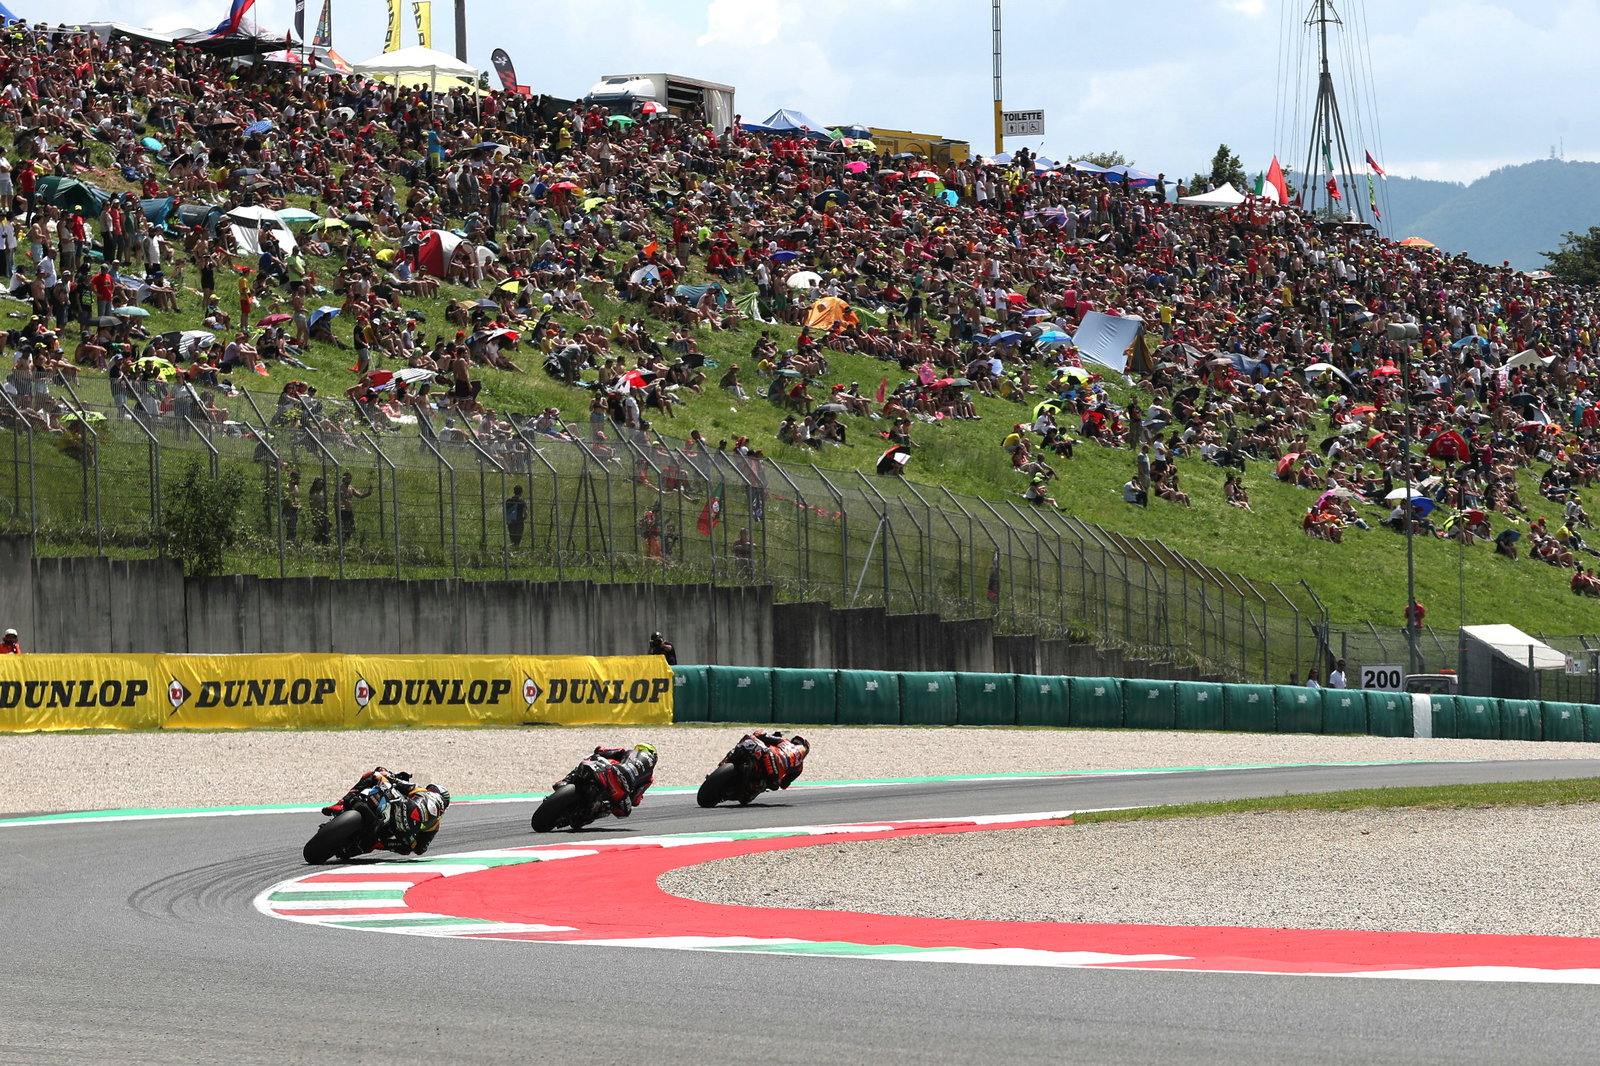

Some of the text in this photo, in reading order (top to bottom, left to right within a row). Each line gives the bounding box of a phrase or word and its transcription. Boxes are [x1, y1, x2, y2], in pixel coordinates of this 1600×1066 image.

[1003, 111, 1042, 121] TOILETTE
[546, 678, 670, 704] DUNLOP
[1364, 670, 1400, 688] 200
[0, 680, 149, 709] DUNLOP
[194, 679, 336, 708] DUNLOP
[378, 679, 512, 706] DUNLOP
